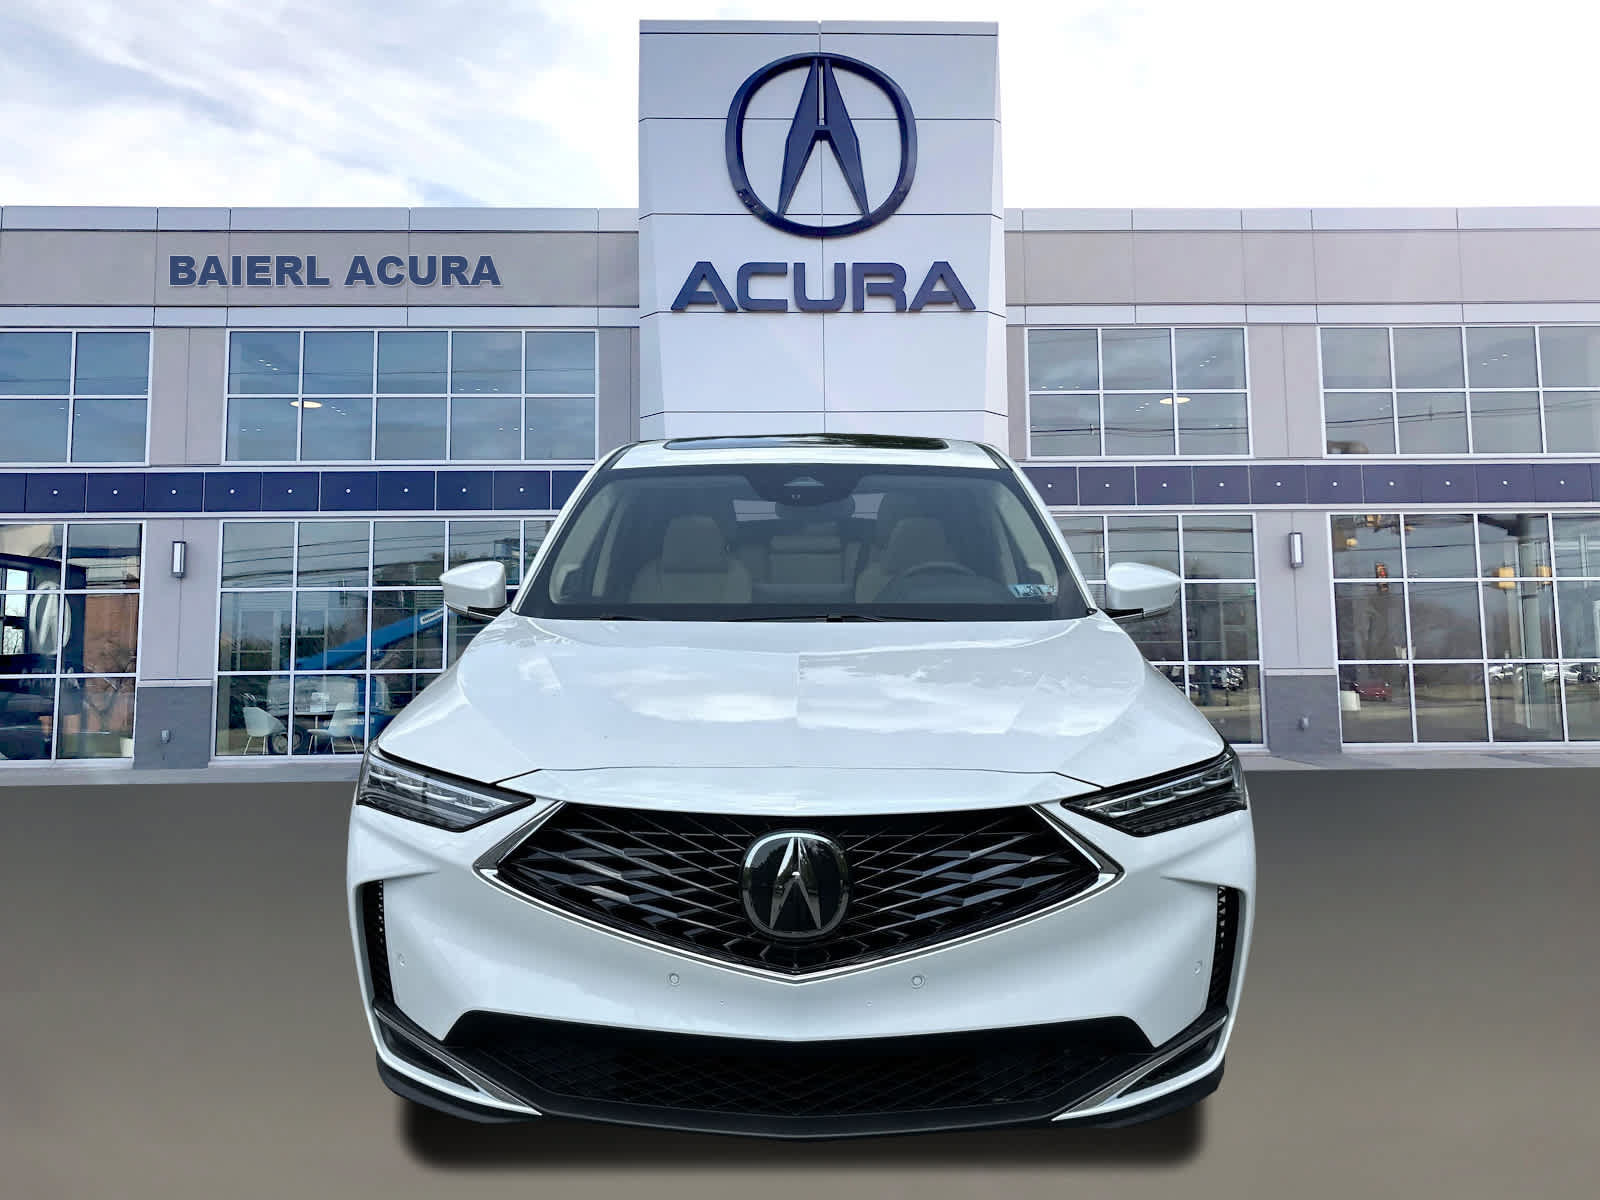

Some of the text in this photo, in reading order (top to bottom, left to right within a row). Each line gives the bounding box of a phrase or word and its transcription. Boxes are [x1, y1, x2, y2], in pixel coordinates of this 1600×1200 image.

[169, 255, 501, 286] BAIERL ACURA
[670, 261, 976, 312] ACURA
